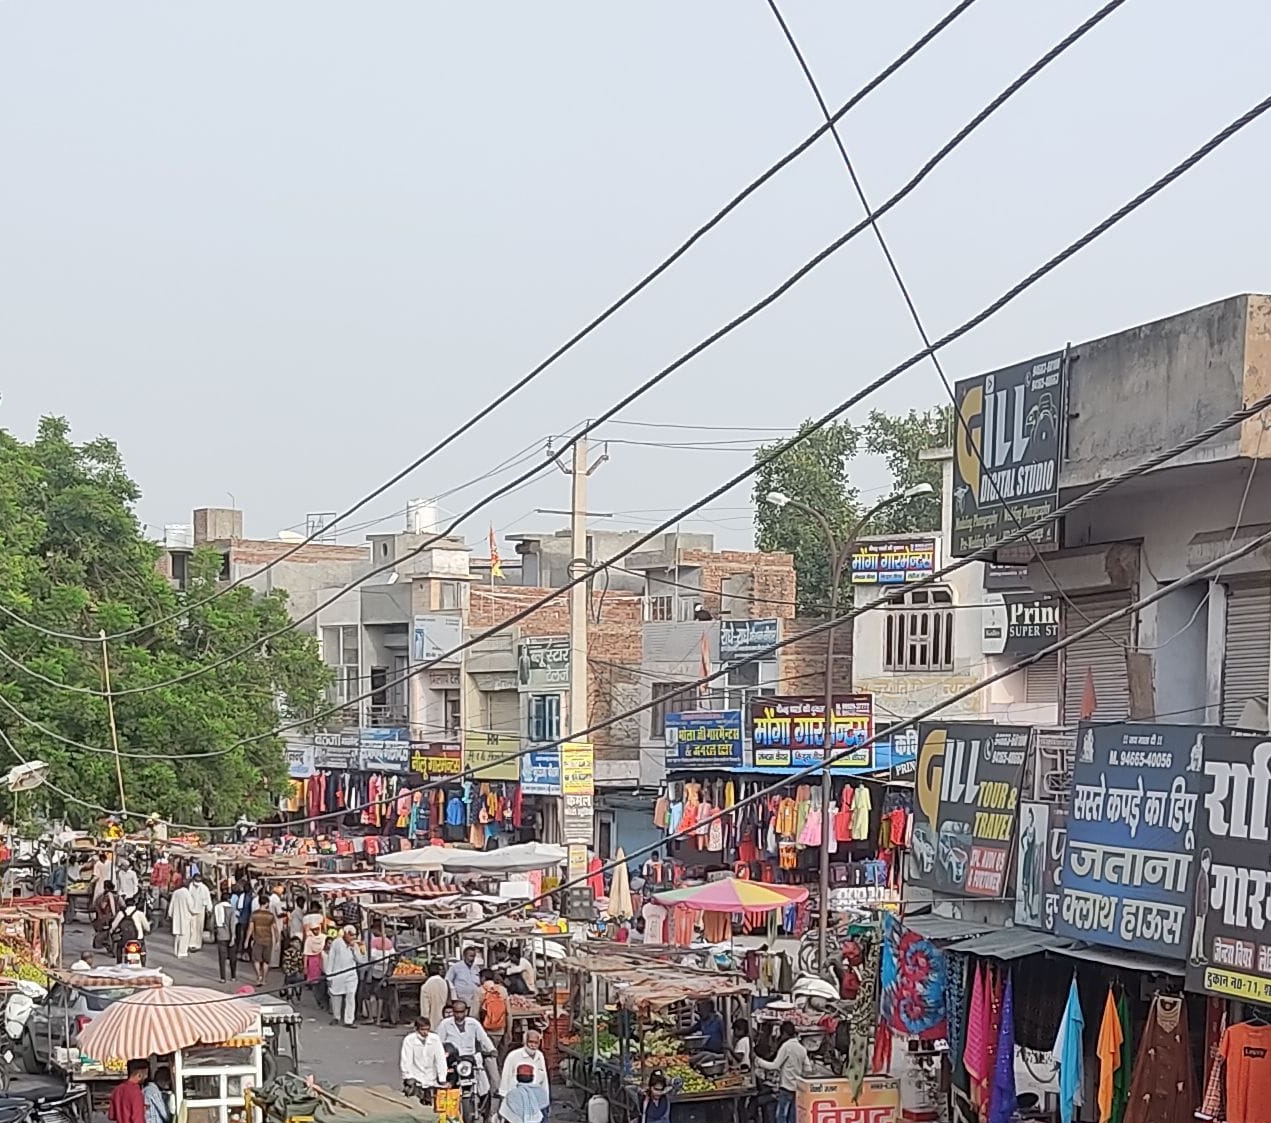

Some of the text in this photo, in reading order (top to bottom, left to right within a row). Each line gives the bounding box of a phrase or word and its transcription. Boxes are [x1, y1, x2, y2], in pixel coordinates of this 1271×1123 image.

[980, 460, 1055, 503] DIGITAL STUDIO
[1009, 626, 1041, 637] SUPER
[977, 781, 1018, 810] TOUR &
[1074, 772, 1198, 850] सस्ते कपड़े का डिपू
[973, 811, 1014, 841] TRAVEL
[1069, 840, 1193, 893] जताना
[1062, 888, 1186, 944] क्लाथ हाऊस
[1207, 972, 1229, 988] दुकान
